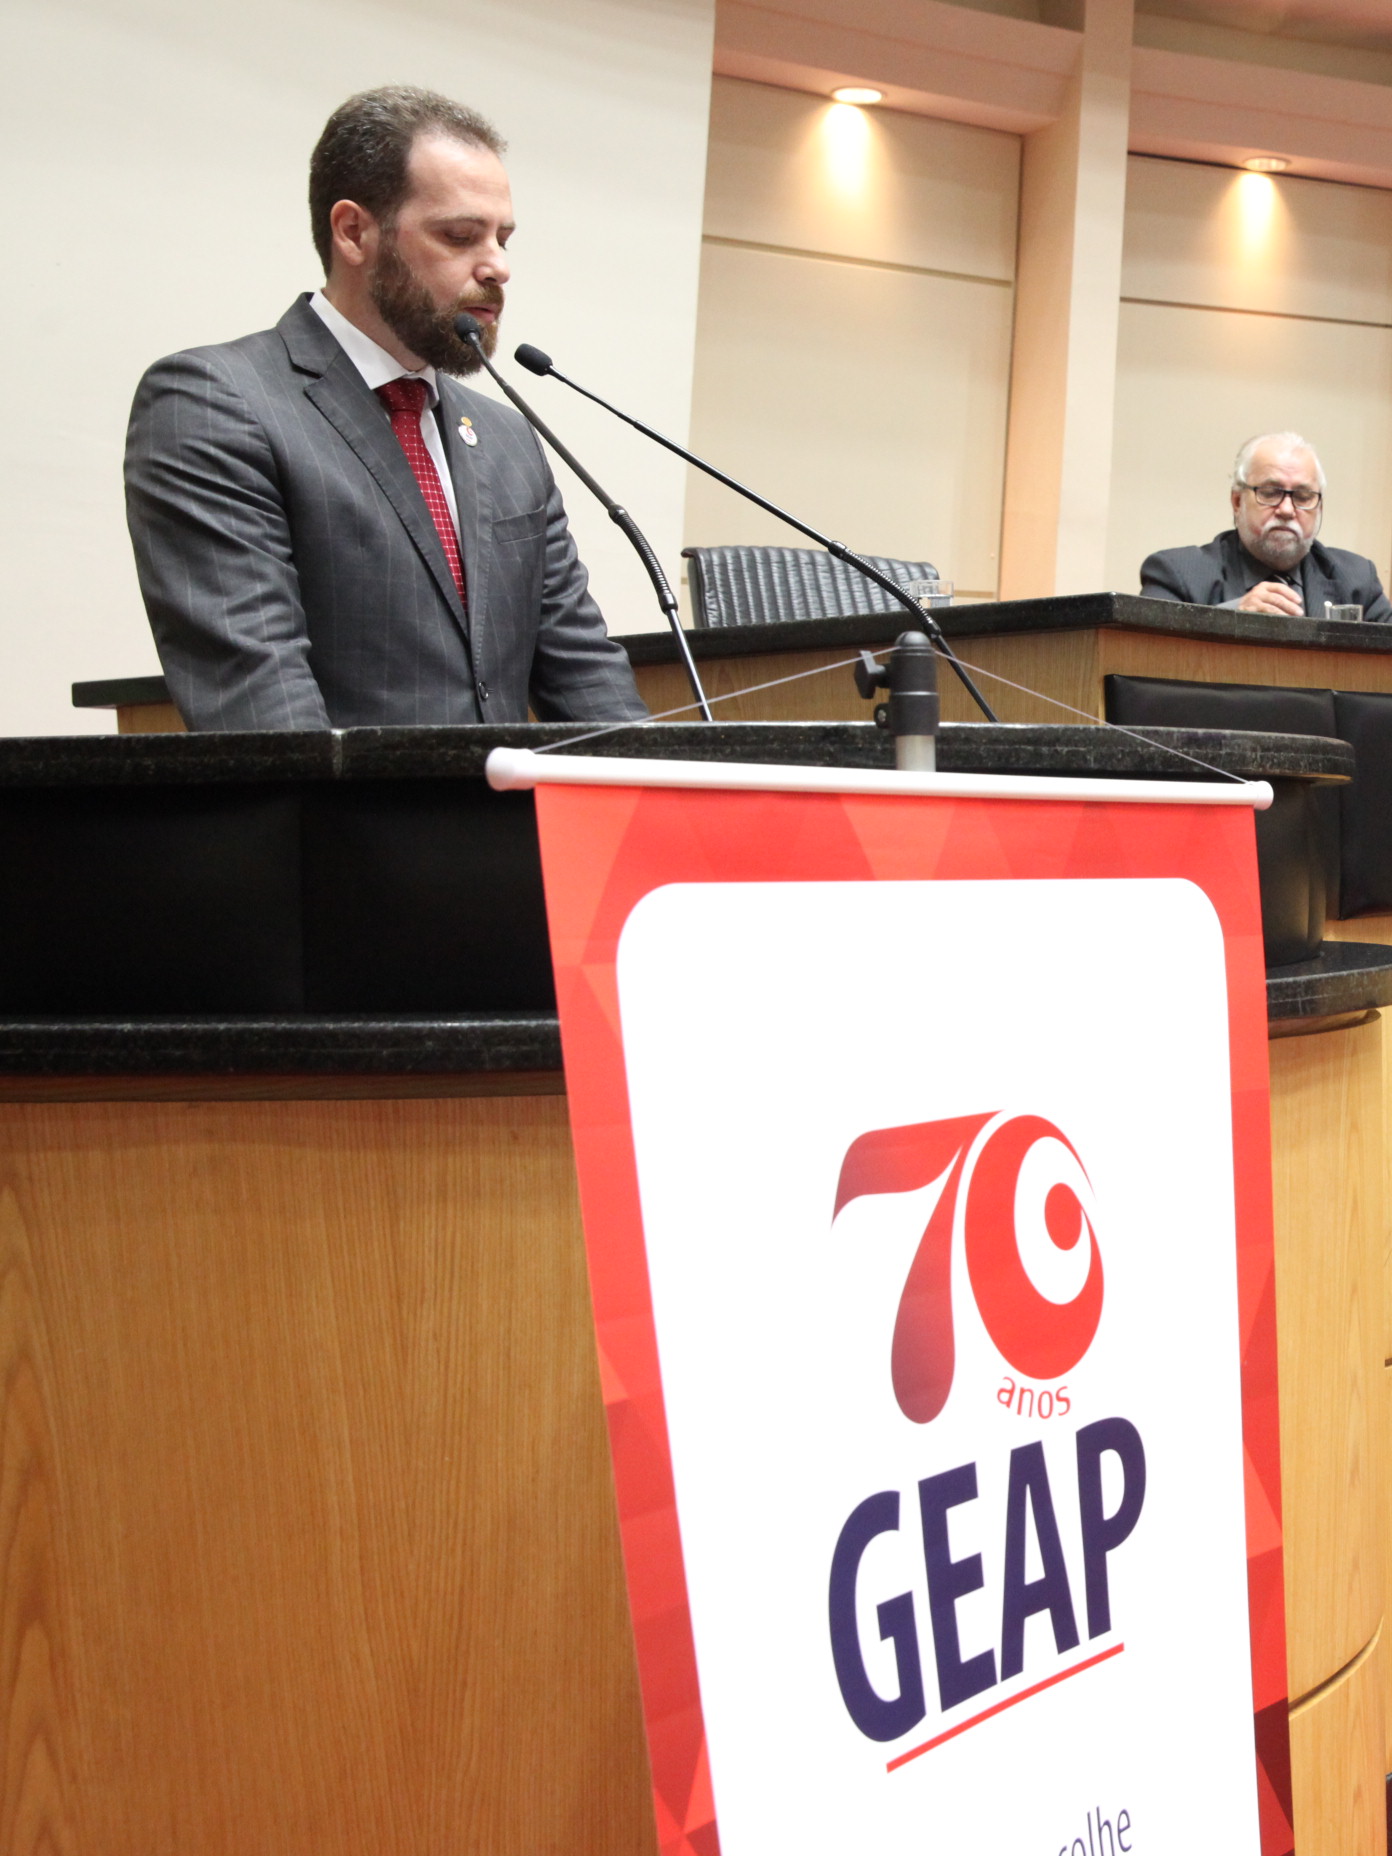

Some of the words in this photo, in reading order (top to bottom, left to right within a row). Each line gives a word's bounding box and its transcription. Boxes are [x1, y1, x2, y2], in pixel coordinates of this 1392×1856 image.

[831, 1110, 1105, 1425] 70
[996, 1376, 1072, 1419] anos
[828, 1416, 1147, 1743] GEAP
